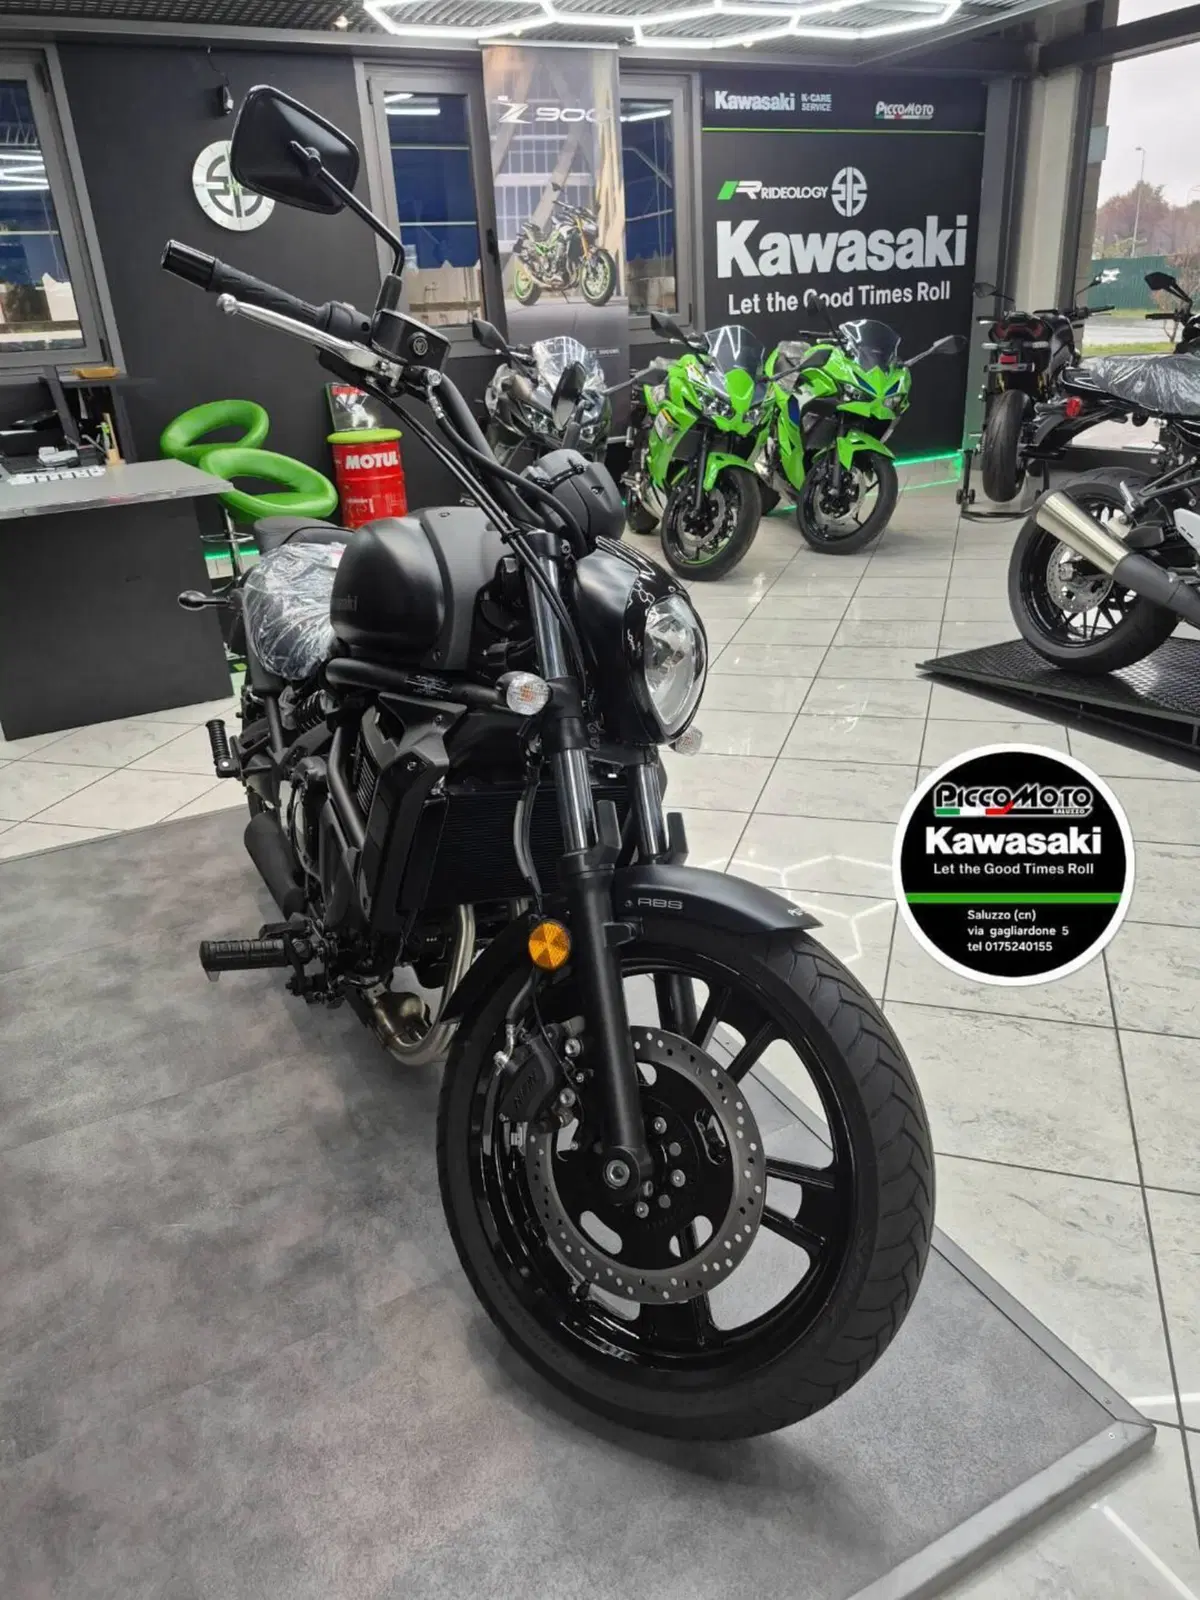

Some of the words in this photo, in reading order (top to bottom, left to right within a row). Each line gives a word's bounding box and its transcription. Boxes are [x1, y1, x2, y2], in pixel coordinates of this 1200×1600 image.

[714, 90, 796, 112] Kawasaki
[801, 103, 832, 112] SERVICE
[761, 186, 828, 199] RIDEOLOGY
[716, 214, 968, 278] Kawasaki
[728, 293, 760, 315] Let
[766, 291, 799, 312] the
[858, 283, 913, 306] Times
[917, 280, 951, 302] Roll
[345, 451, 399, 470] MOTUL
